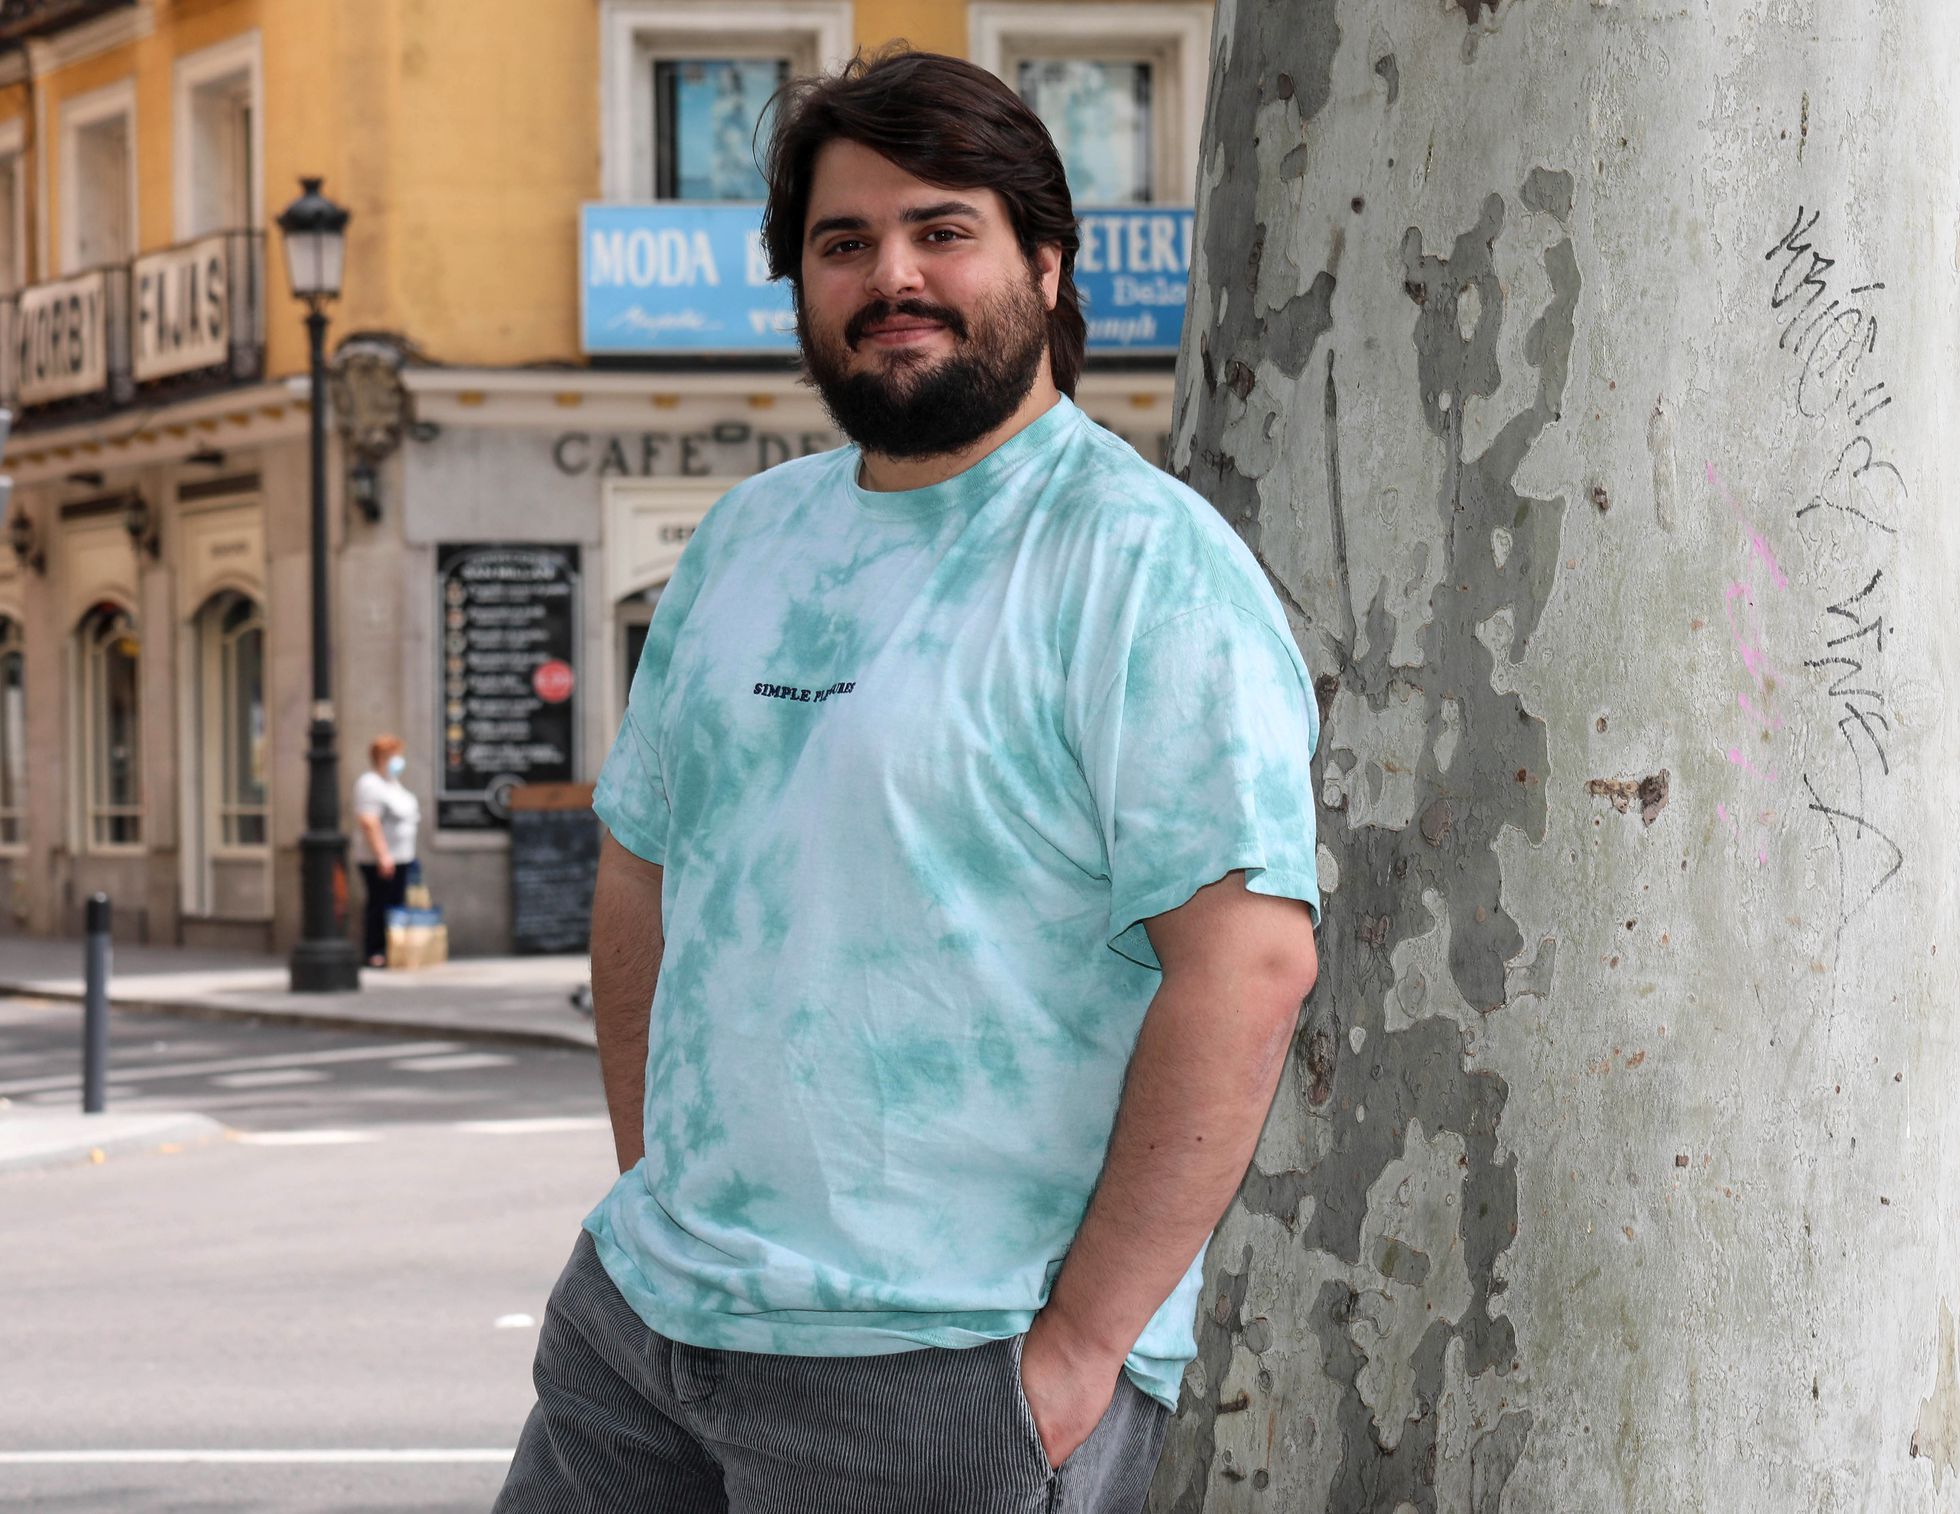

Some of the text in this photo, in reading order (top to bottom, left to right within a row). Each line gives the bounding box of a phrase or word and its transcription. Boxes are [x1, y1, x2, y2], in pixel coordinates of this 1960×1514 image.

[591, 228, 720, 287] MODA
[1072, 215, 1195, 273] ETERI
[753, 682, 811, 702] SIMPLE
